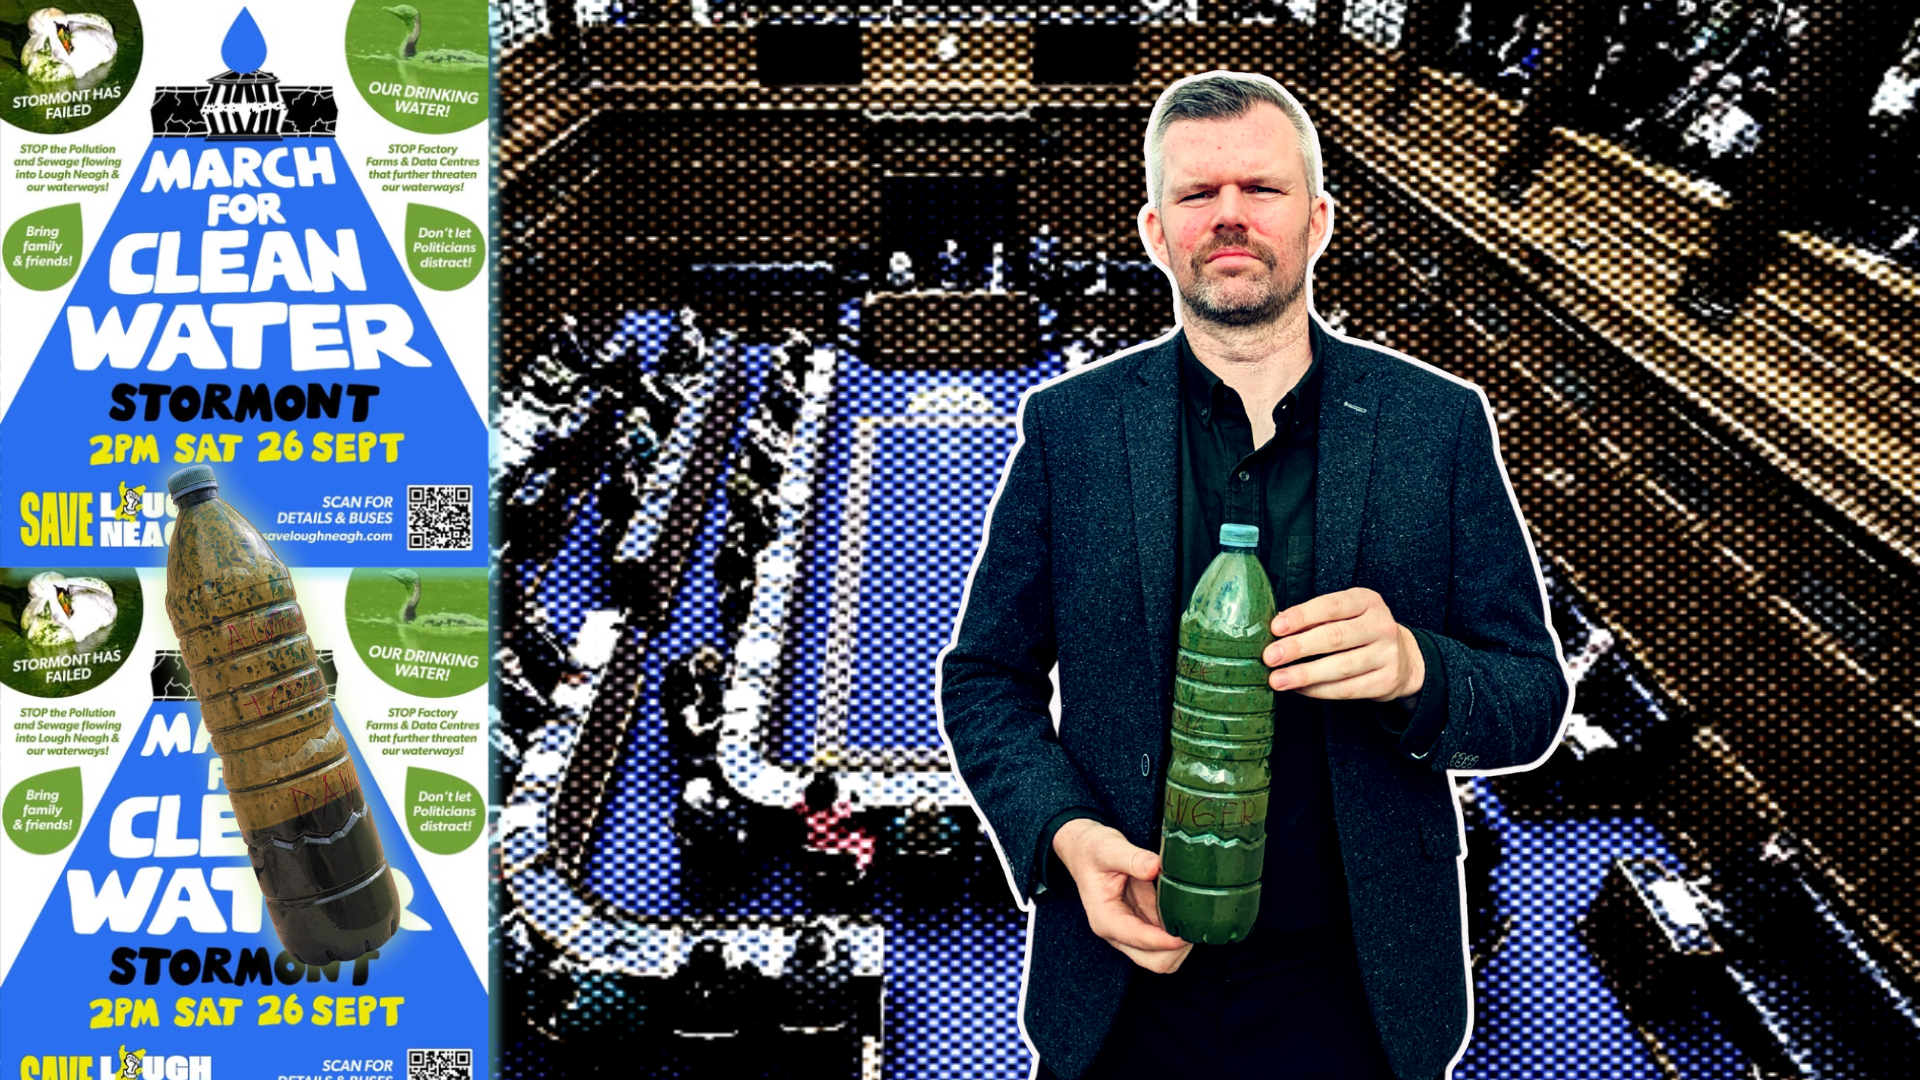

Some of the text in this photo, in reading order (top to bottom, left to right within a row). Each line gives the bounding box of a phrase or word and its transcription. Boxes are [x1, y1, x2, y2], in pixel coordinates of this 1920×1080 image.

[13, 86, 121, 108] STORMONT HAS
[368, 81, 479, 105] OUR DRINKING
[46, 104, 92, 120] FAILED
[395, 100, 451, 118] WATER!
[20, 144, 116, 154] STOP the Pollution
[388, 144, 458, 156] STOP Factory
[13, 156, 122, 169] and Sewage flowing
[366, 157, 480, 167] Farms & Data Centres
[15, 169, 120, 181] into Lough Neagh &
[140, 146, 337, 193] MARCH
[368, 169, 478, 181] that further threaten
[26, 182, 109, 194] our waterways!
[381, 182, 464, 194] our waterways!
[207, 192, 287, 227] FOR
[25, 226, 60, 240] Bring
[418, 227, 472, 239] Don't let
[22, 240, 63, 254] family
[413, 241, 477, 253] Politicians
[12, 254, 73, 269] & friends!
[108, 228, 367, 295] CLEAN
[420, 256, 472, 268] distract!
[66, 301, 433, 372] WATER
[109, 383, 380, 423] STORMONT
[89, 430, 405, 466] 2PM SAT 26 SEPT
[322, 495, 394, 509] SCAN FOR
[20, 491, 94, 547] SAVE
[276, 511, 393, 525] DETAILS & BUSES
[99, 520, 175, 548] NEA
[262, 530, 393, 544] saveloughneagh.com
[13, 650, 121, 672] STORMONT HAS
[368, 645, 479, 669] OUR DRINKING
[46, 668, 92, 684] FAILED
[395, 664, 451, 682] WATER!
[20, 708, 116, 718] STOP the Pollution
[388, 708, 458, 720] STOP Factory
[13, 720, 122, 733] and Sewage flowing
[366, 721, 480, 731] Farms & Data Centres
[15, 733, 120, 745] into Lough Neagh &
[368, 733, 478, 745] that further threaten
[26, 746, 109, 758] our waterways!
[381, 746, 464, 758] our waterways!
[25, 790, 60, 804] Bring
[418, 791, 472, 803] Don't let
[22, 804, 63, 818] family
[413, 805, 477, 817] Politicians
[1164, 787, 1258, 832] ANGER
[12, 818, 73, 833] & friends!
[108, 793, 249, 859] CLE
[420, 820, 472, 832] distract!
[89, 994, 405, 1030] 2PM SAT 26 SEPT
[322, 1059, 394, 1073] SCAN FOR
